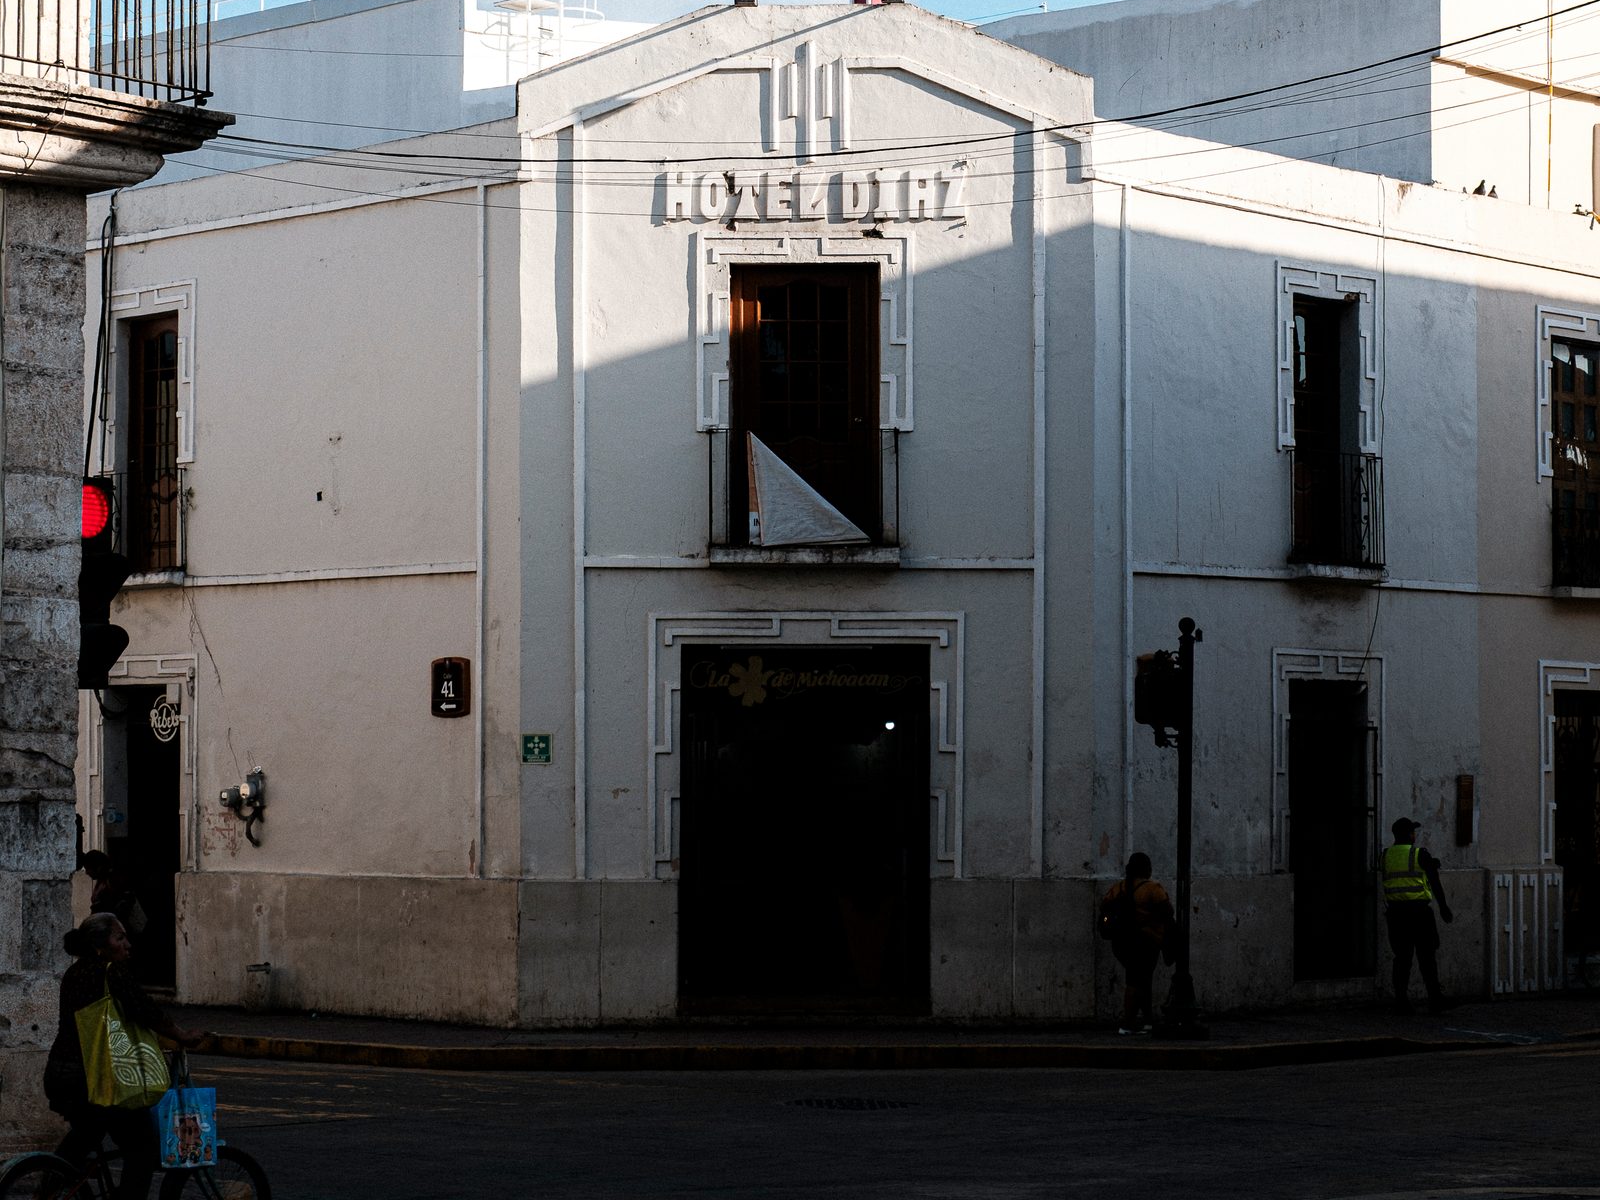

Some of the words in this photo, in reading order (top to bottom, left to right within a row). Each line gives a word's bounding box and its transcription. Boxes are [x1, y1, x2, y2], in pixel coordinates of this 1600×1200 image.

[665, 169, 827, 221] HOTEL
[842, 168, 967, 219] DIAZ
[707, 670, 731, 688] La
[771, 670, 793, 688] de
[441, 680, 455, 698] 41
